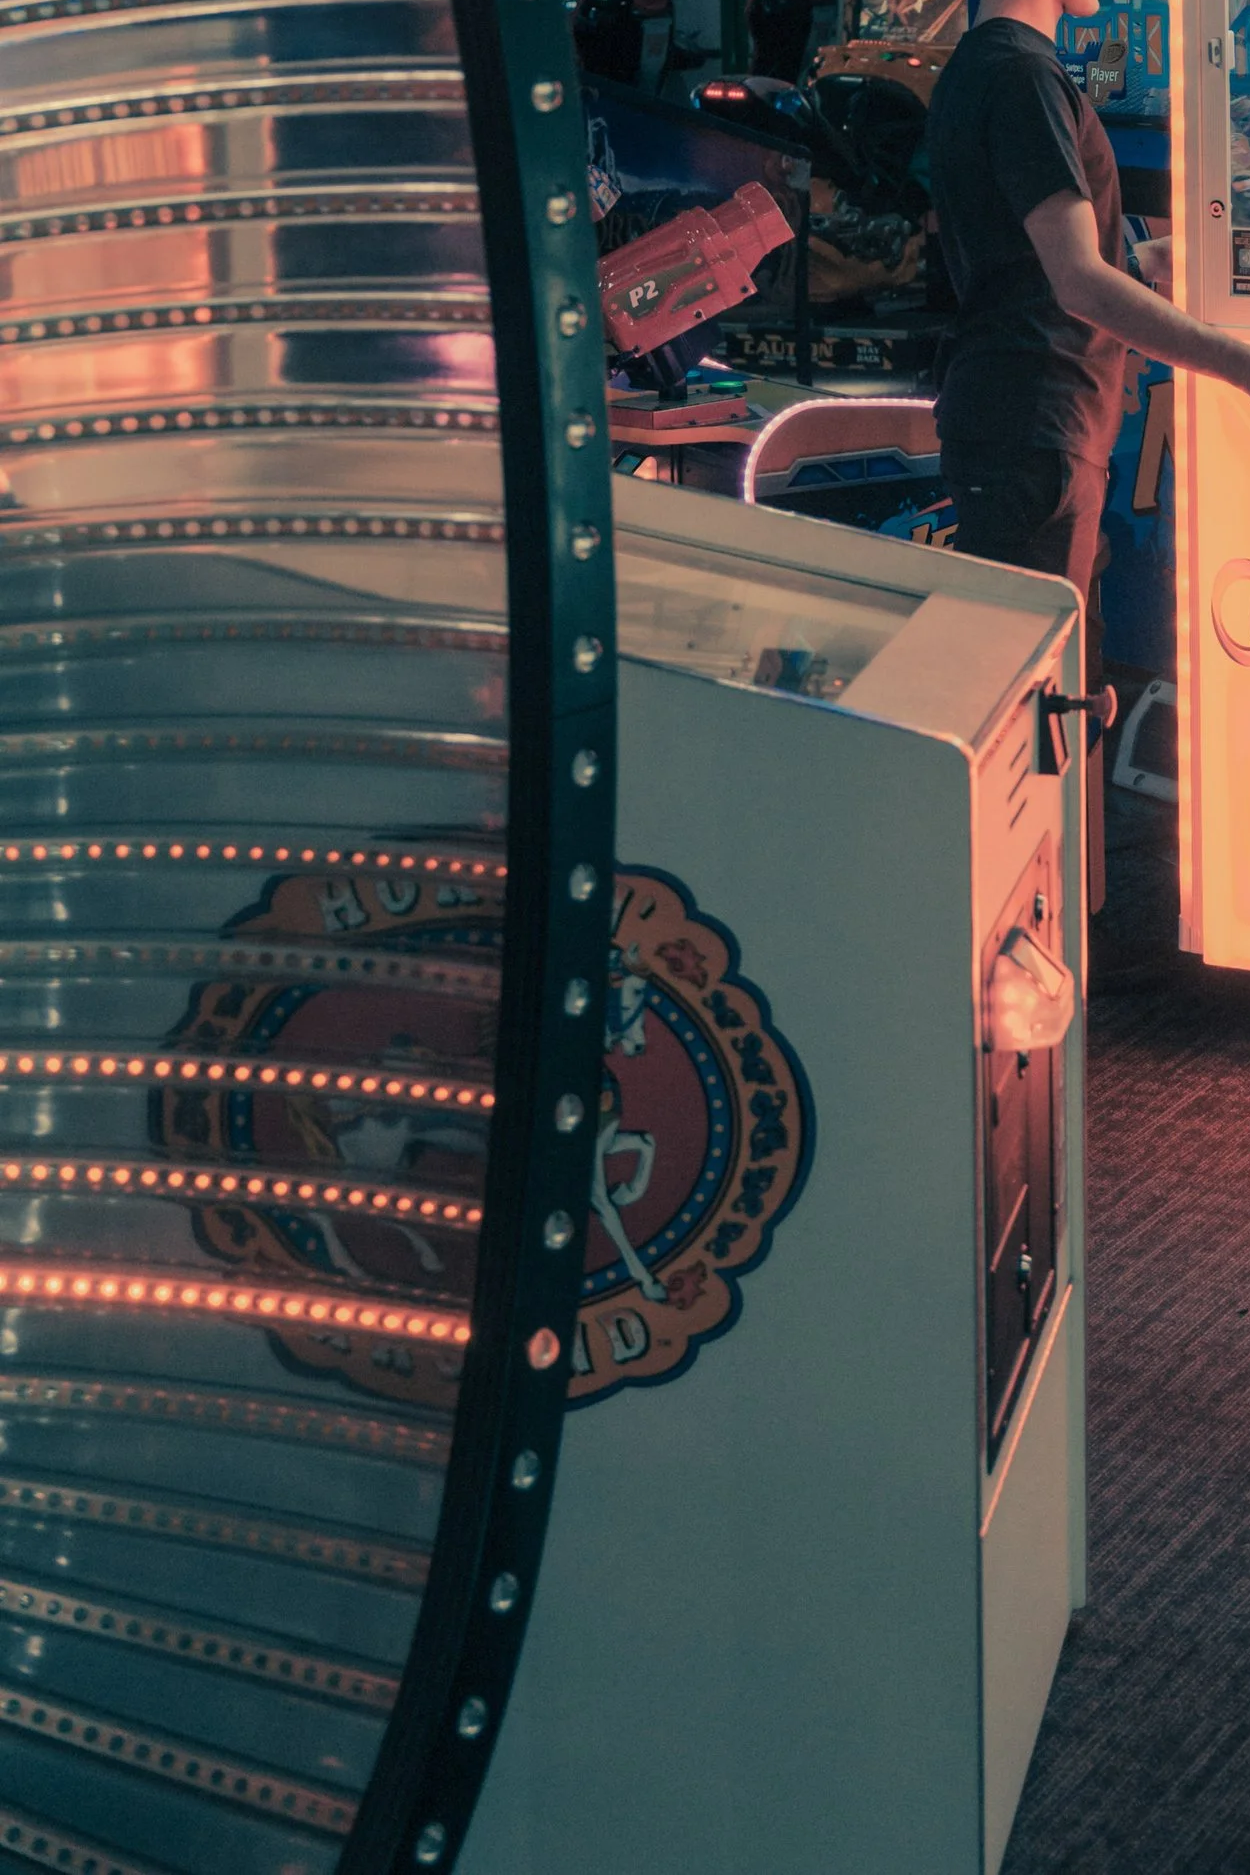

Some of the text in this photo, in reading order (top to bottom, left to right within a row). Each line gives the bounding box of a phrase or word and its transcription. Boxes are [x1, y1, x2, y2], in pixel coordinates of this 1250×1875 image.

[1090, 67, 1119, 83] Player
[1095, 84, 1099, 97] 1
[627, 279, 659, 308] P2
